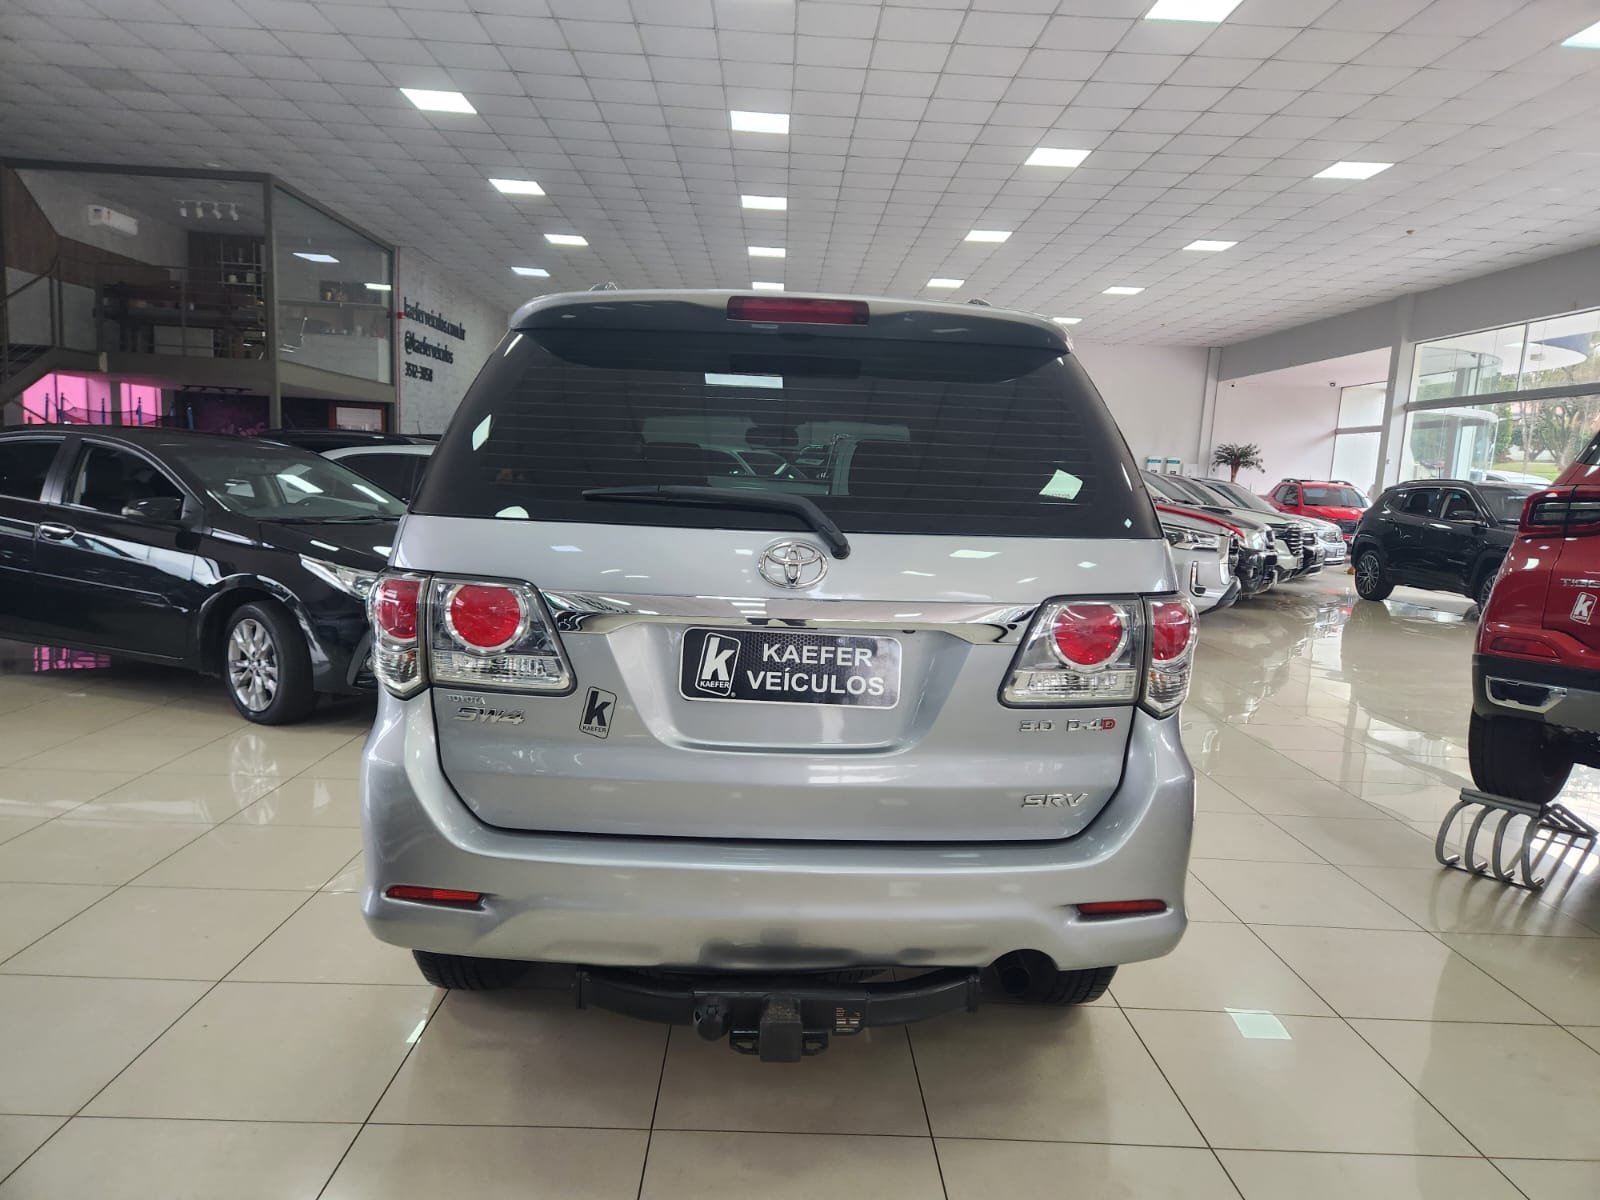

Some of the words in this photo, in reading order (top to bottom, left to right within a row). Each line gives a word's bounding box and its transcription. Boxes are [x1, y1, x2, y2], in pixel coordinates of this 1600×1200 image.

[763, 643, 873, 667] KAEFER
[746, 668, 886, 696] VEÍCULOS
[447, 694, 486, 705] TOYOTA
[454, 706, 525, 725] SW4
[1021, 793, 1088, 808] SRV
